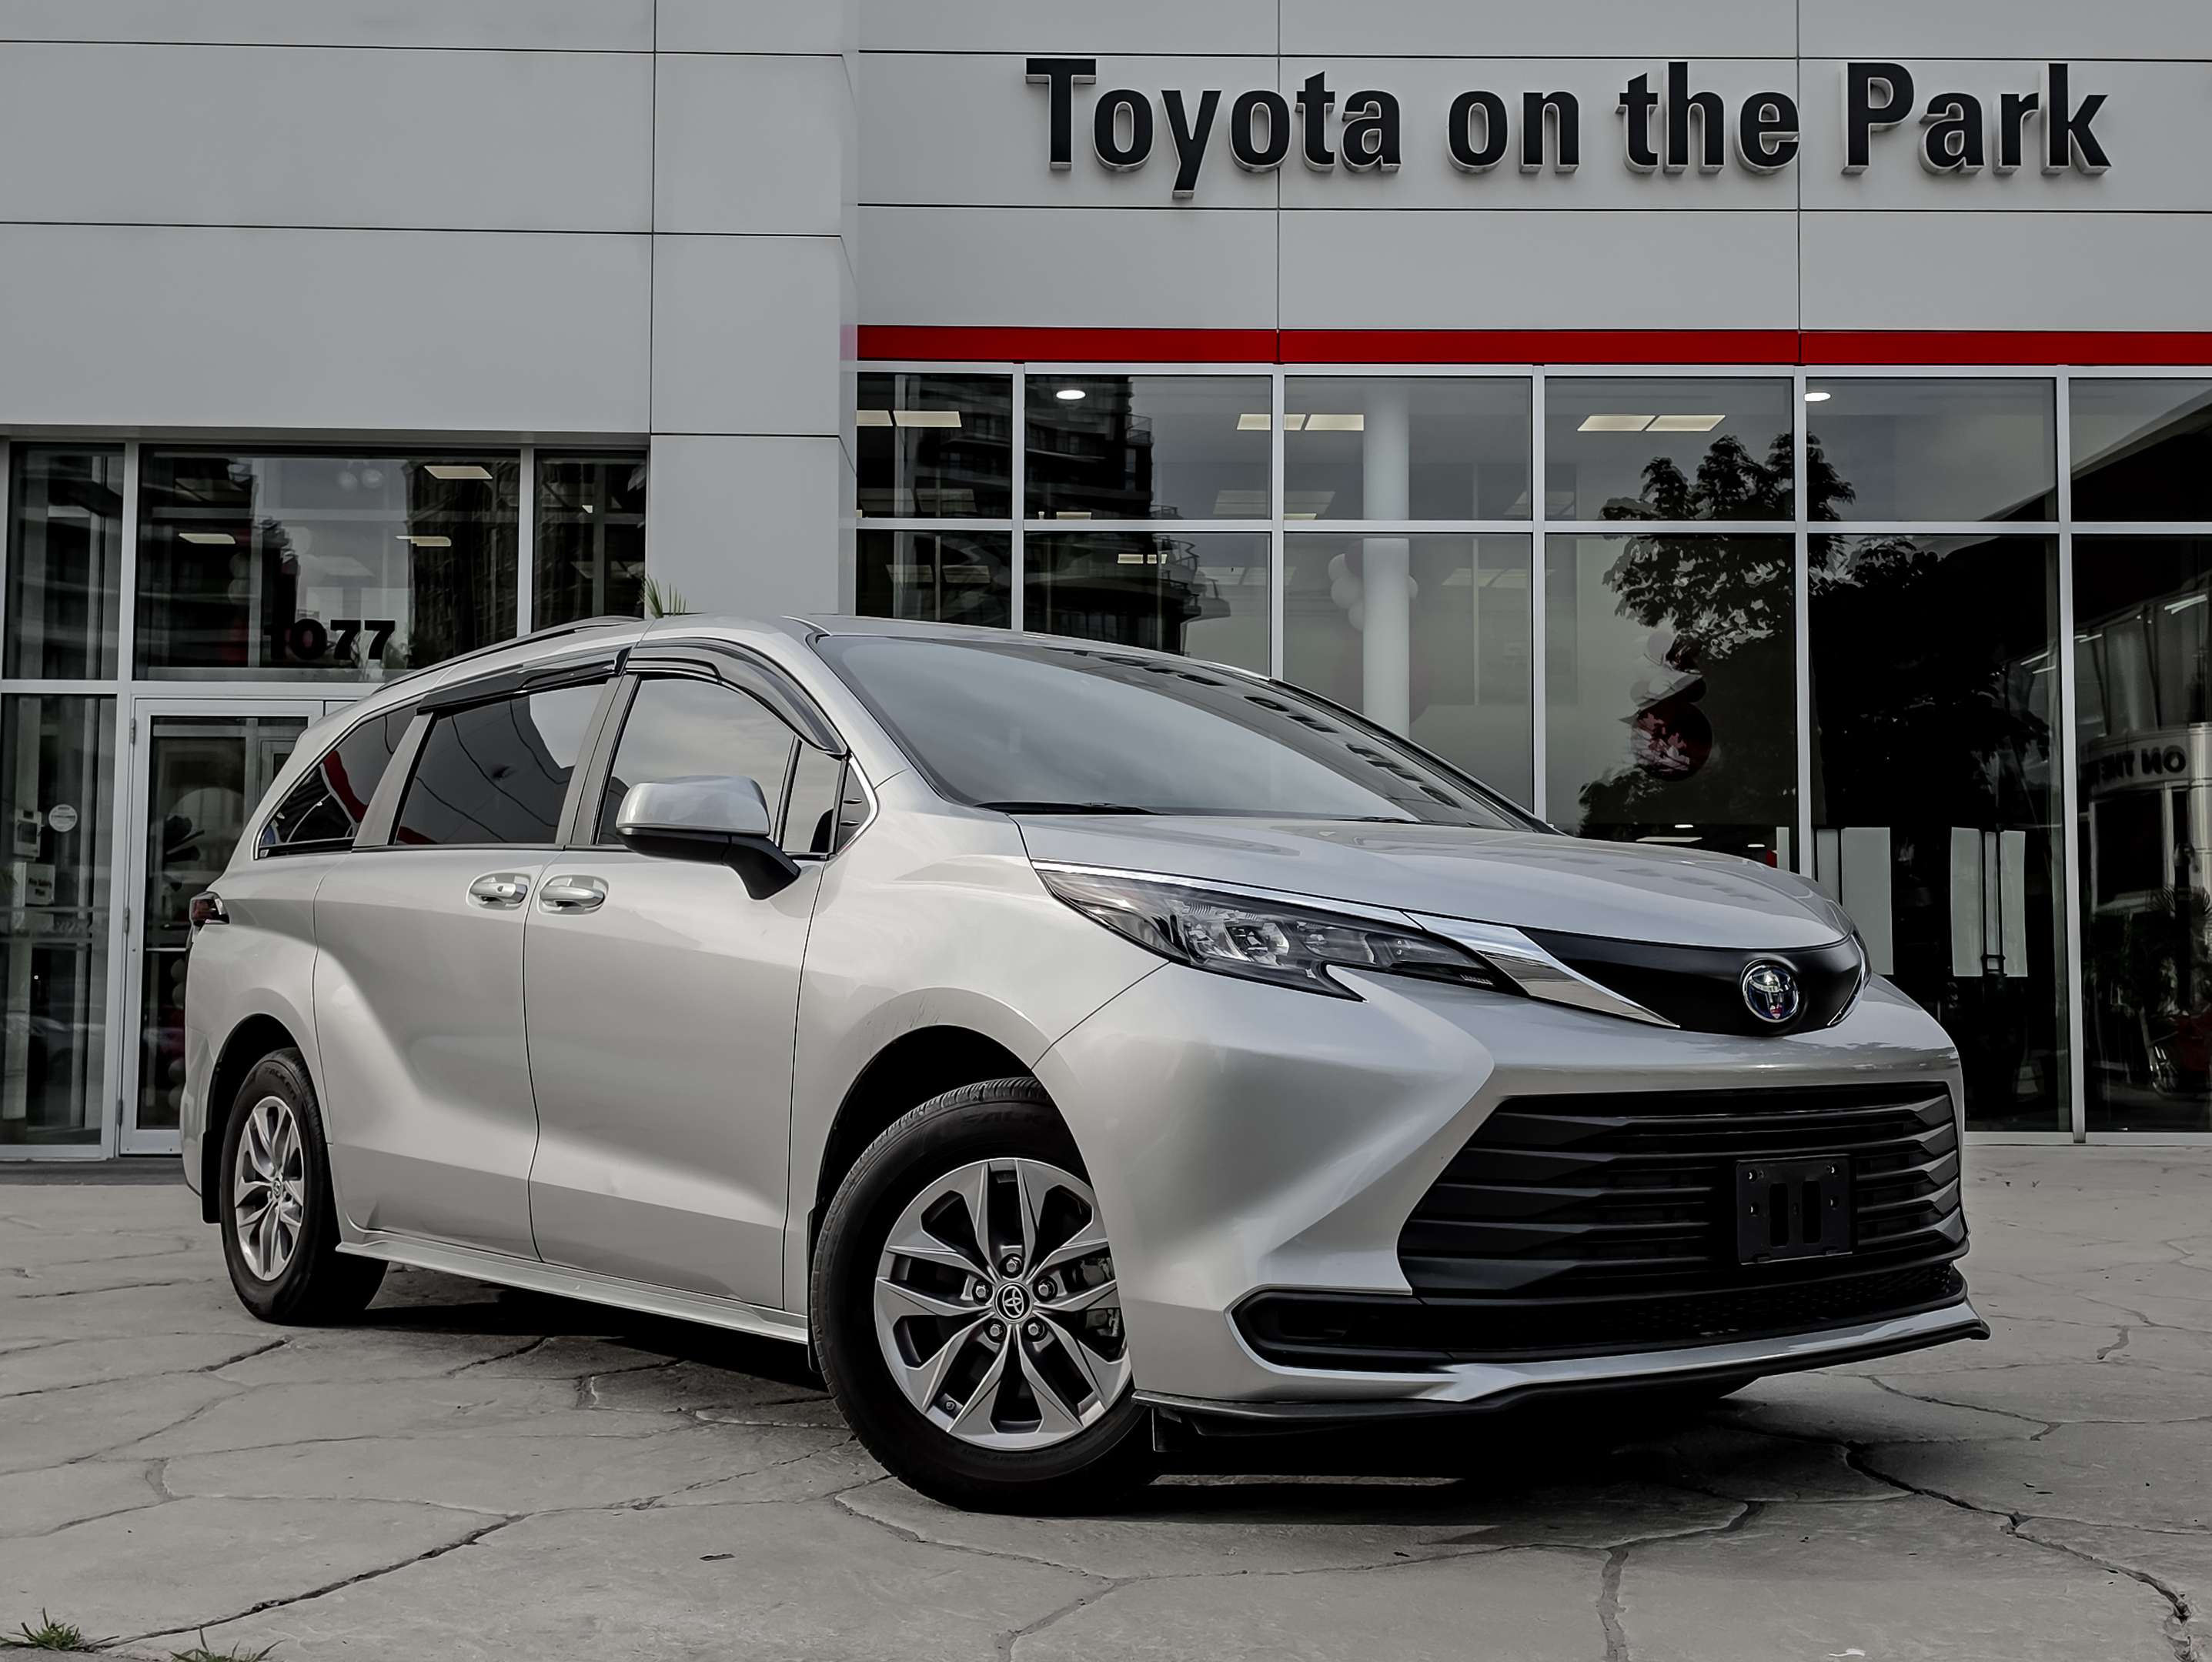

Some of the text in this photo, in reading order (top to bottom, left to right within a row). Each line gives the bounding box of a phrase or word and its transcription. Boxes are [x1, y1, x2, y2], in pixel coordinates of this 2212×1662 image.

[1025, 58, 2112, 199] Toyota on the Park
[263, 618, 395, 659] 1077
